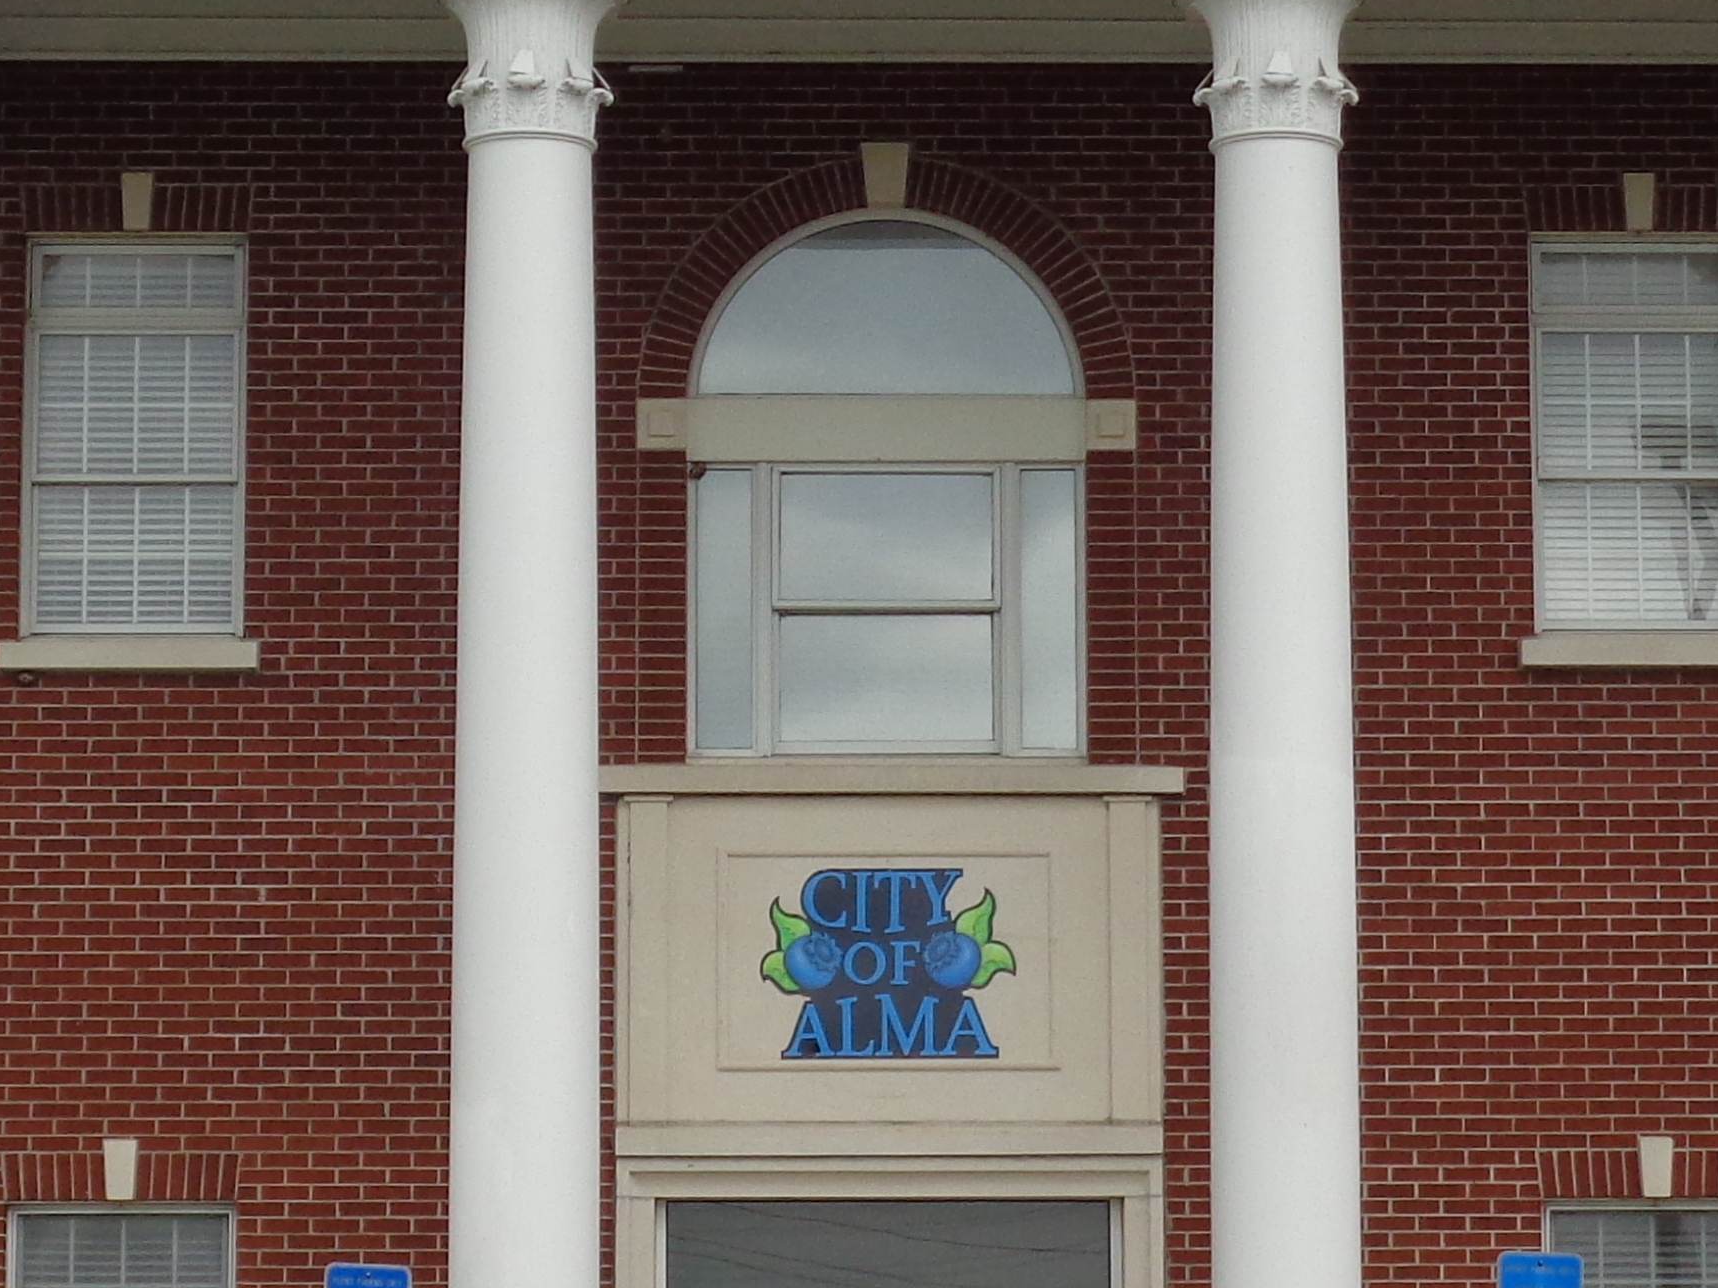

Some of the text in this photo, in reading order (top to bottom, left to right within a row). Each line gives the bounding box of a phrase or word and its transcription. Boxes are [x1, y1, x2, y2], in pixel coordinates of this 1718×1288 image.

[802, 869, 962, 933] CITY
[843, 940, 920, 987] OF
[783, 993, 998, 1058] ALMA
